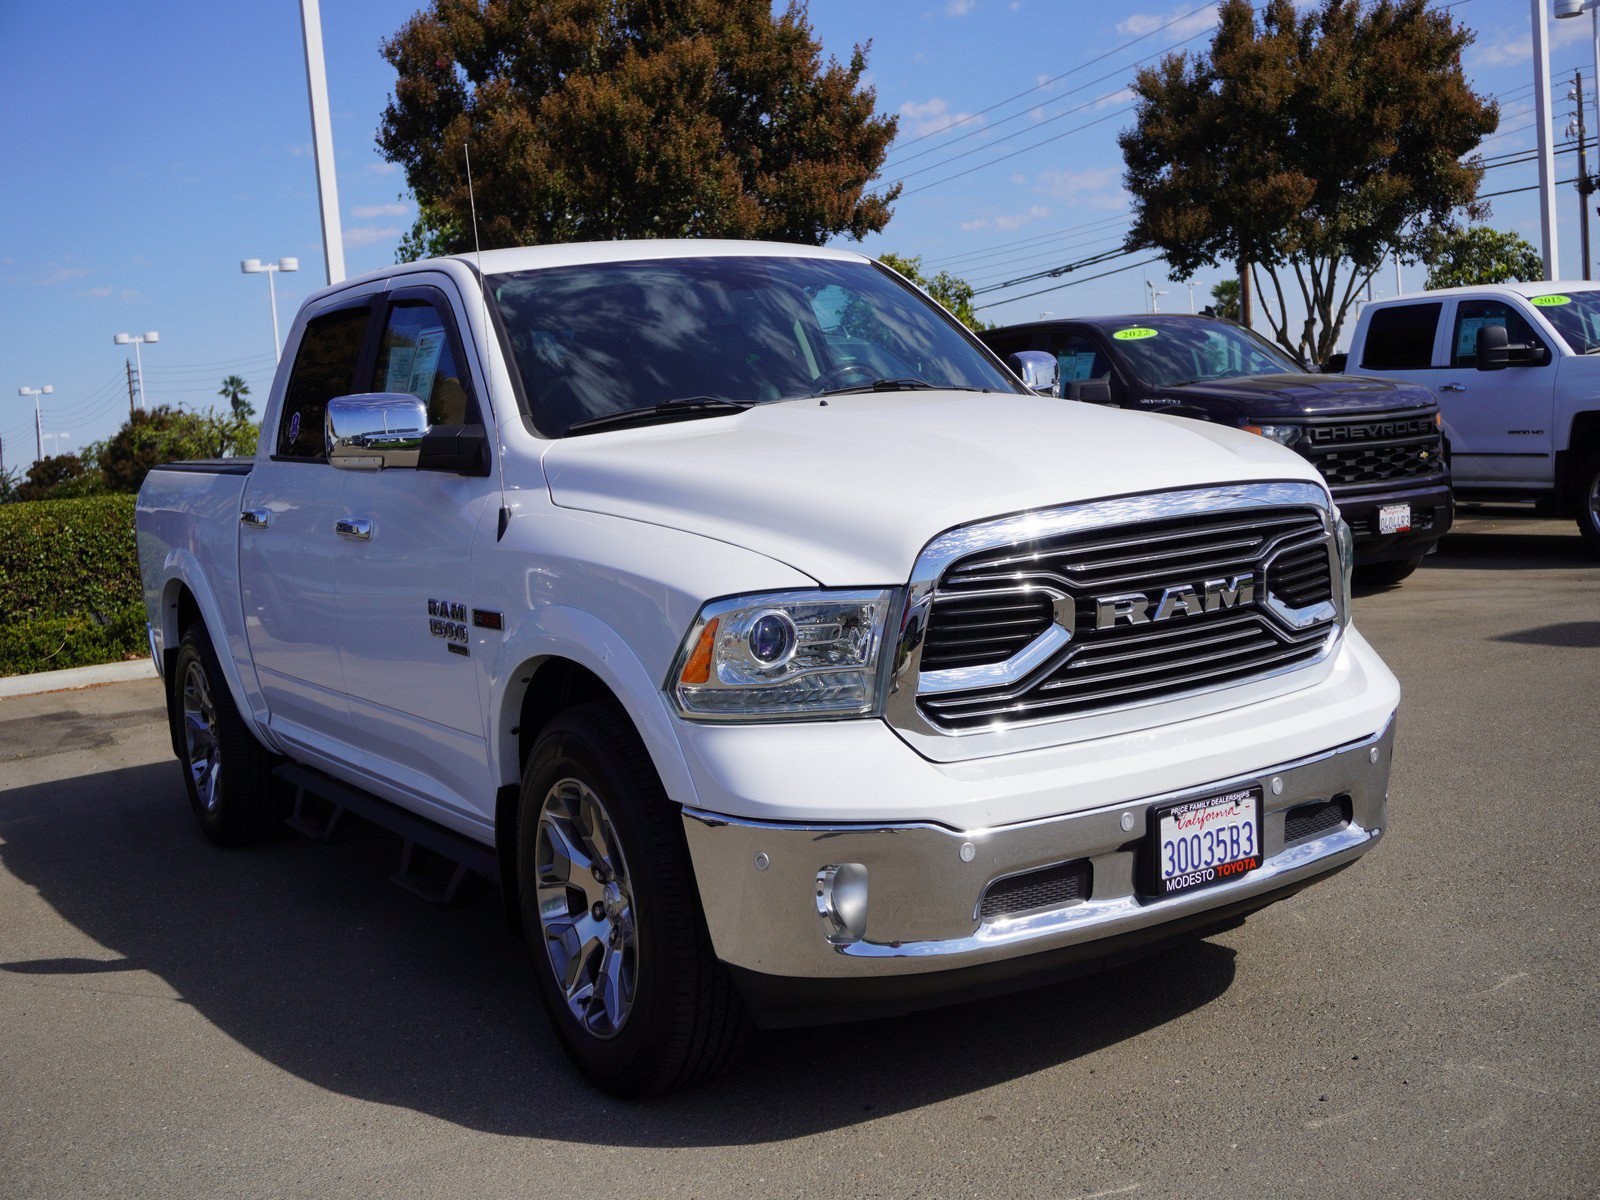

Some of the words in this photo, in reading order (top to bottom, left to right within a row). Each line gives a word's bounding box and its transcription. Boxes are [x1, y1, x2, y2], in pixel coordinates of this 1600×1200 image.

[1539, 296, 1563, 304] 2015
[1123, 329, 1149, 338] 2022
[1314, 420, 1432, 440] CHEVROLE
[427, 598, 468, 622] RAM
[1096, 572, 1254, 630] RAM
[429, 618, 469, 643] 1500
[1170, 806, 1189, 815] PRICE
[1189, 801, 1211, 812] FAMILY
[1210, 791, 1250, 806] DEALERSHIPS
[1177, 806, 1241, 830] California
[1163, 821, 1254, 877] 30035B3
[1166, 868, 1215, 892] MODESTO
[1216, 857, 1257, 878] TOYOTA
